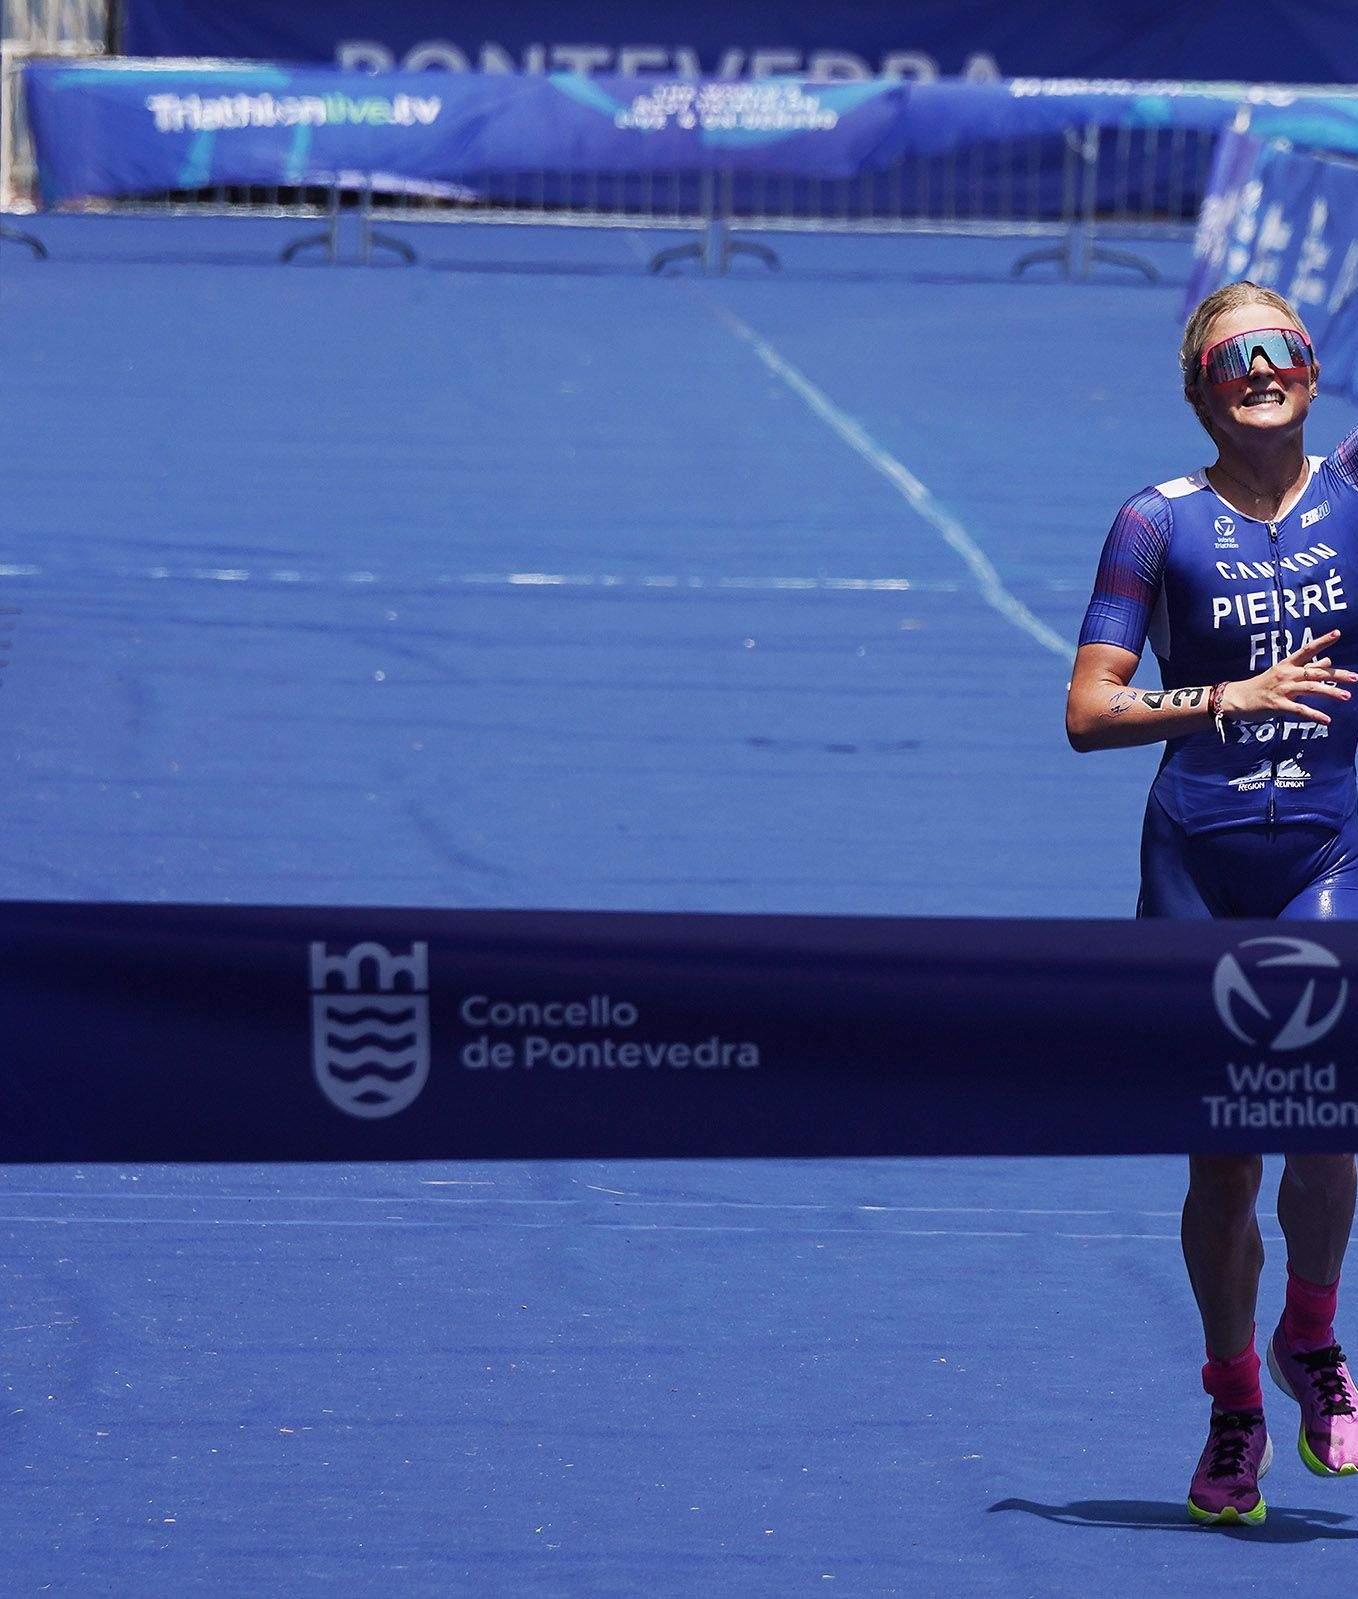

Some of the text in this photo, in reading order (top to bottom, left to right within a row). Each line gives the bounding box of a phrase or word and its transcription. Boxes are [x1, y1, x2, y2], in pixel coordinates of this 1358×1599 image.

[1215, 543, 1338, 580] CANYON
[1212, 568, 1348, 629] PIERRÉ
[459, 995, 640, 1029] Concello
[460, 1036, 762, 1068] de Pontevedra
[1227, 1063, 1337, 1093] World
